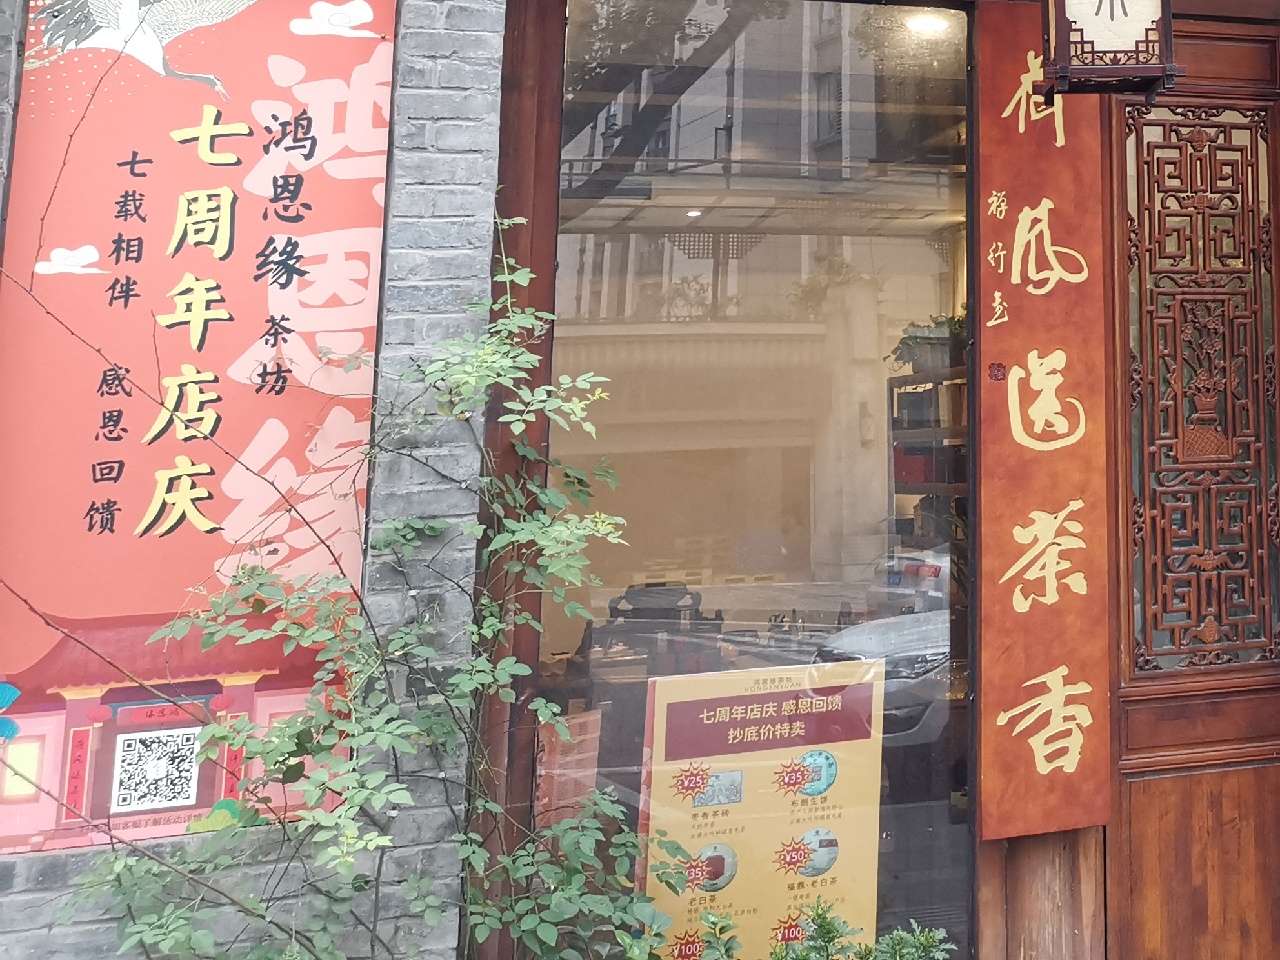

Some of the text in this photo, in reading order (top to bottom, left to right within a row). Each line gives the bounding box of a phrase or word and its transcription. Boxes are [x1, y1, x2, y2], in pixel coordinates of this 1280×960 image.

[252, 106, 318, 398] 鸿恩缘 茶坊
[132, 103, 254, 539] 七周年店庆
[83, 150, 154, 535] 七载相伴 感恩回馈
[699, 695, 843, 724] 七周年店庆 感恩回馈
[727, 721, 806, 744] 抄底价特卖
[683, 775, 703, 787] ¥25
[783, 771, 803, 784] ¥35
[785, 850, 805, 862] ¥50
[686, 867, 702, 879] 35
[688, 895, 718, 907] 老白茶
[777, 927, 802, 941] ¥100
[673, 943, 700, 957] ¥100
